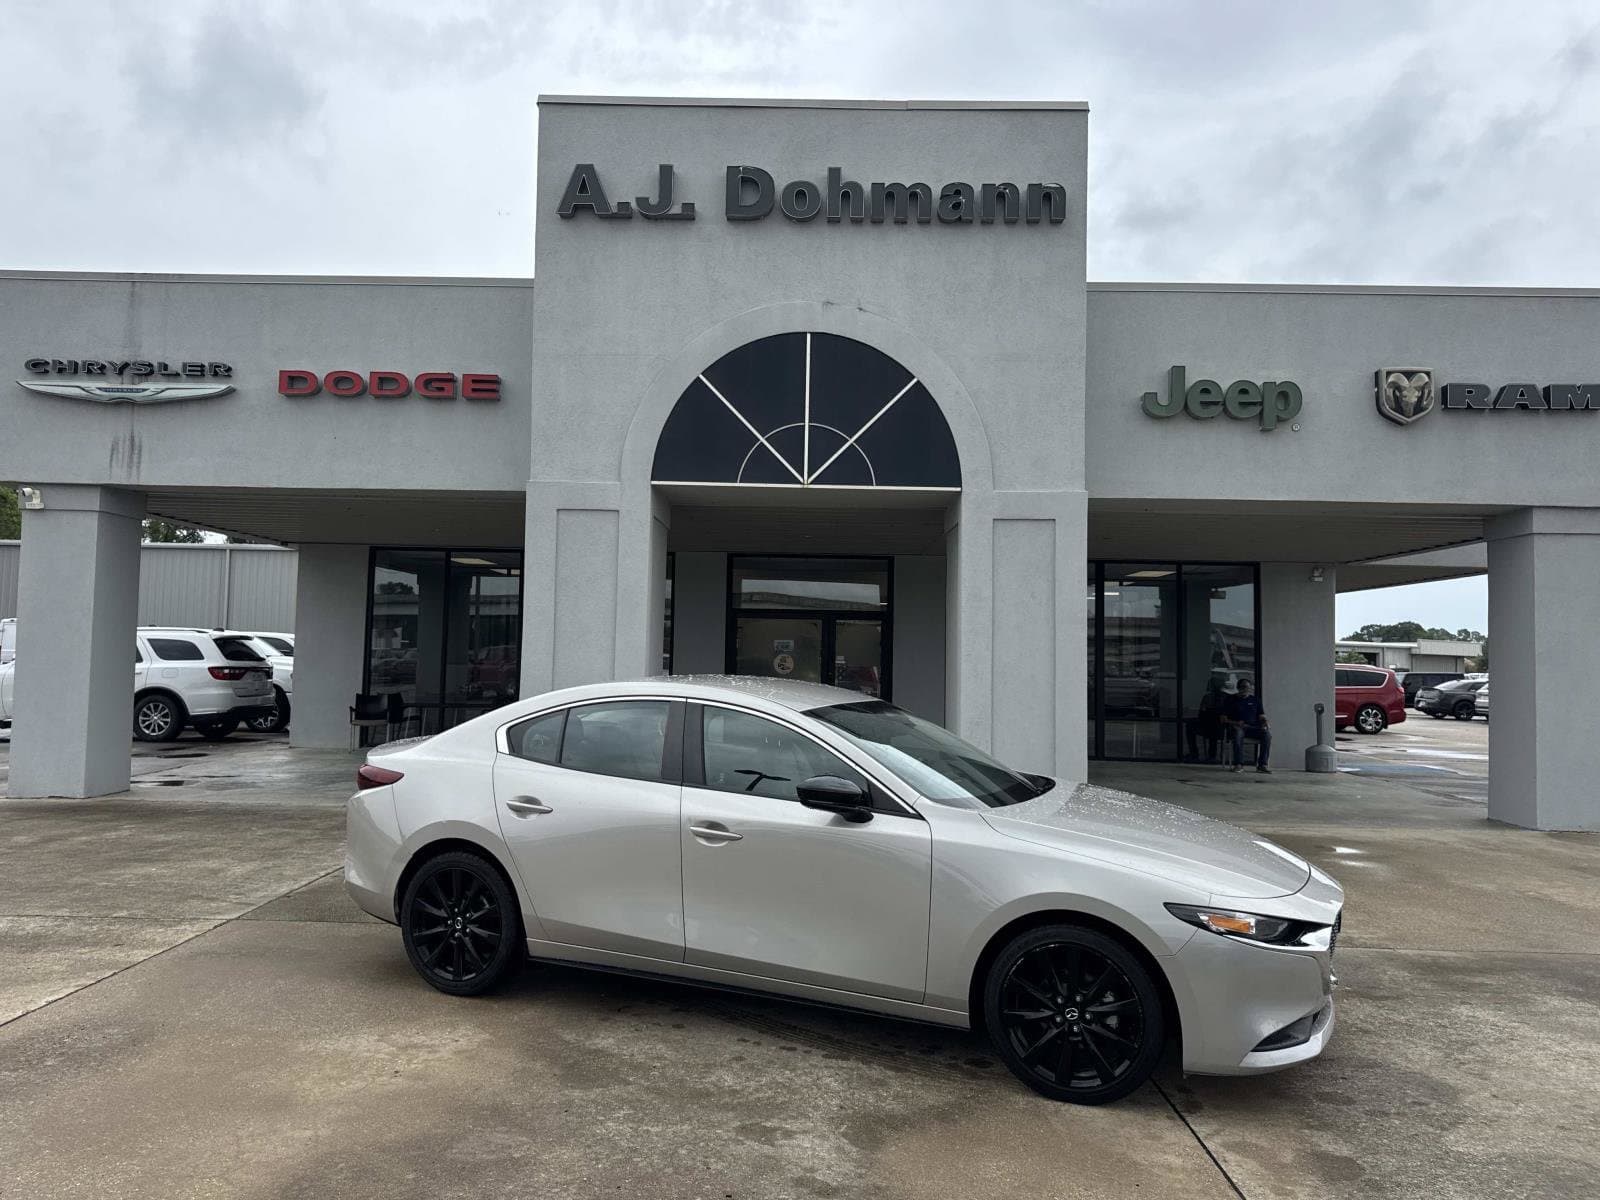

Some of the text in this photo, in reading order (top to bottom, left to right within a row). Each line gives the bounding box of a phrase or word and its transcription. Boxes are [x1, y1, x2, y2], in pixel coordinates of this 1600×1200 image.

[556, 164, 1066, 224] A.J. Dohmann
[24, 358, 233, 378] CHRYSLER
[278, 369, 502, 402] DODGE
[1141, 365, 1303, 431] Jeep
[1441, 383, 1600, 409] RAM
